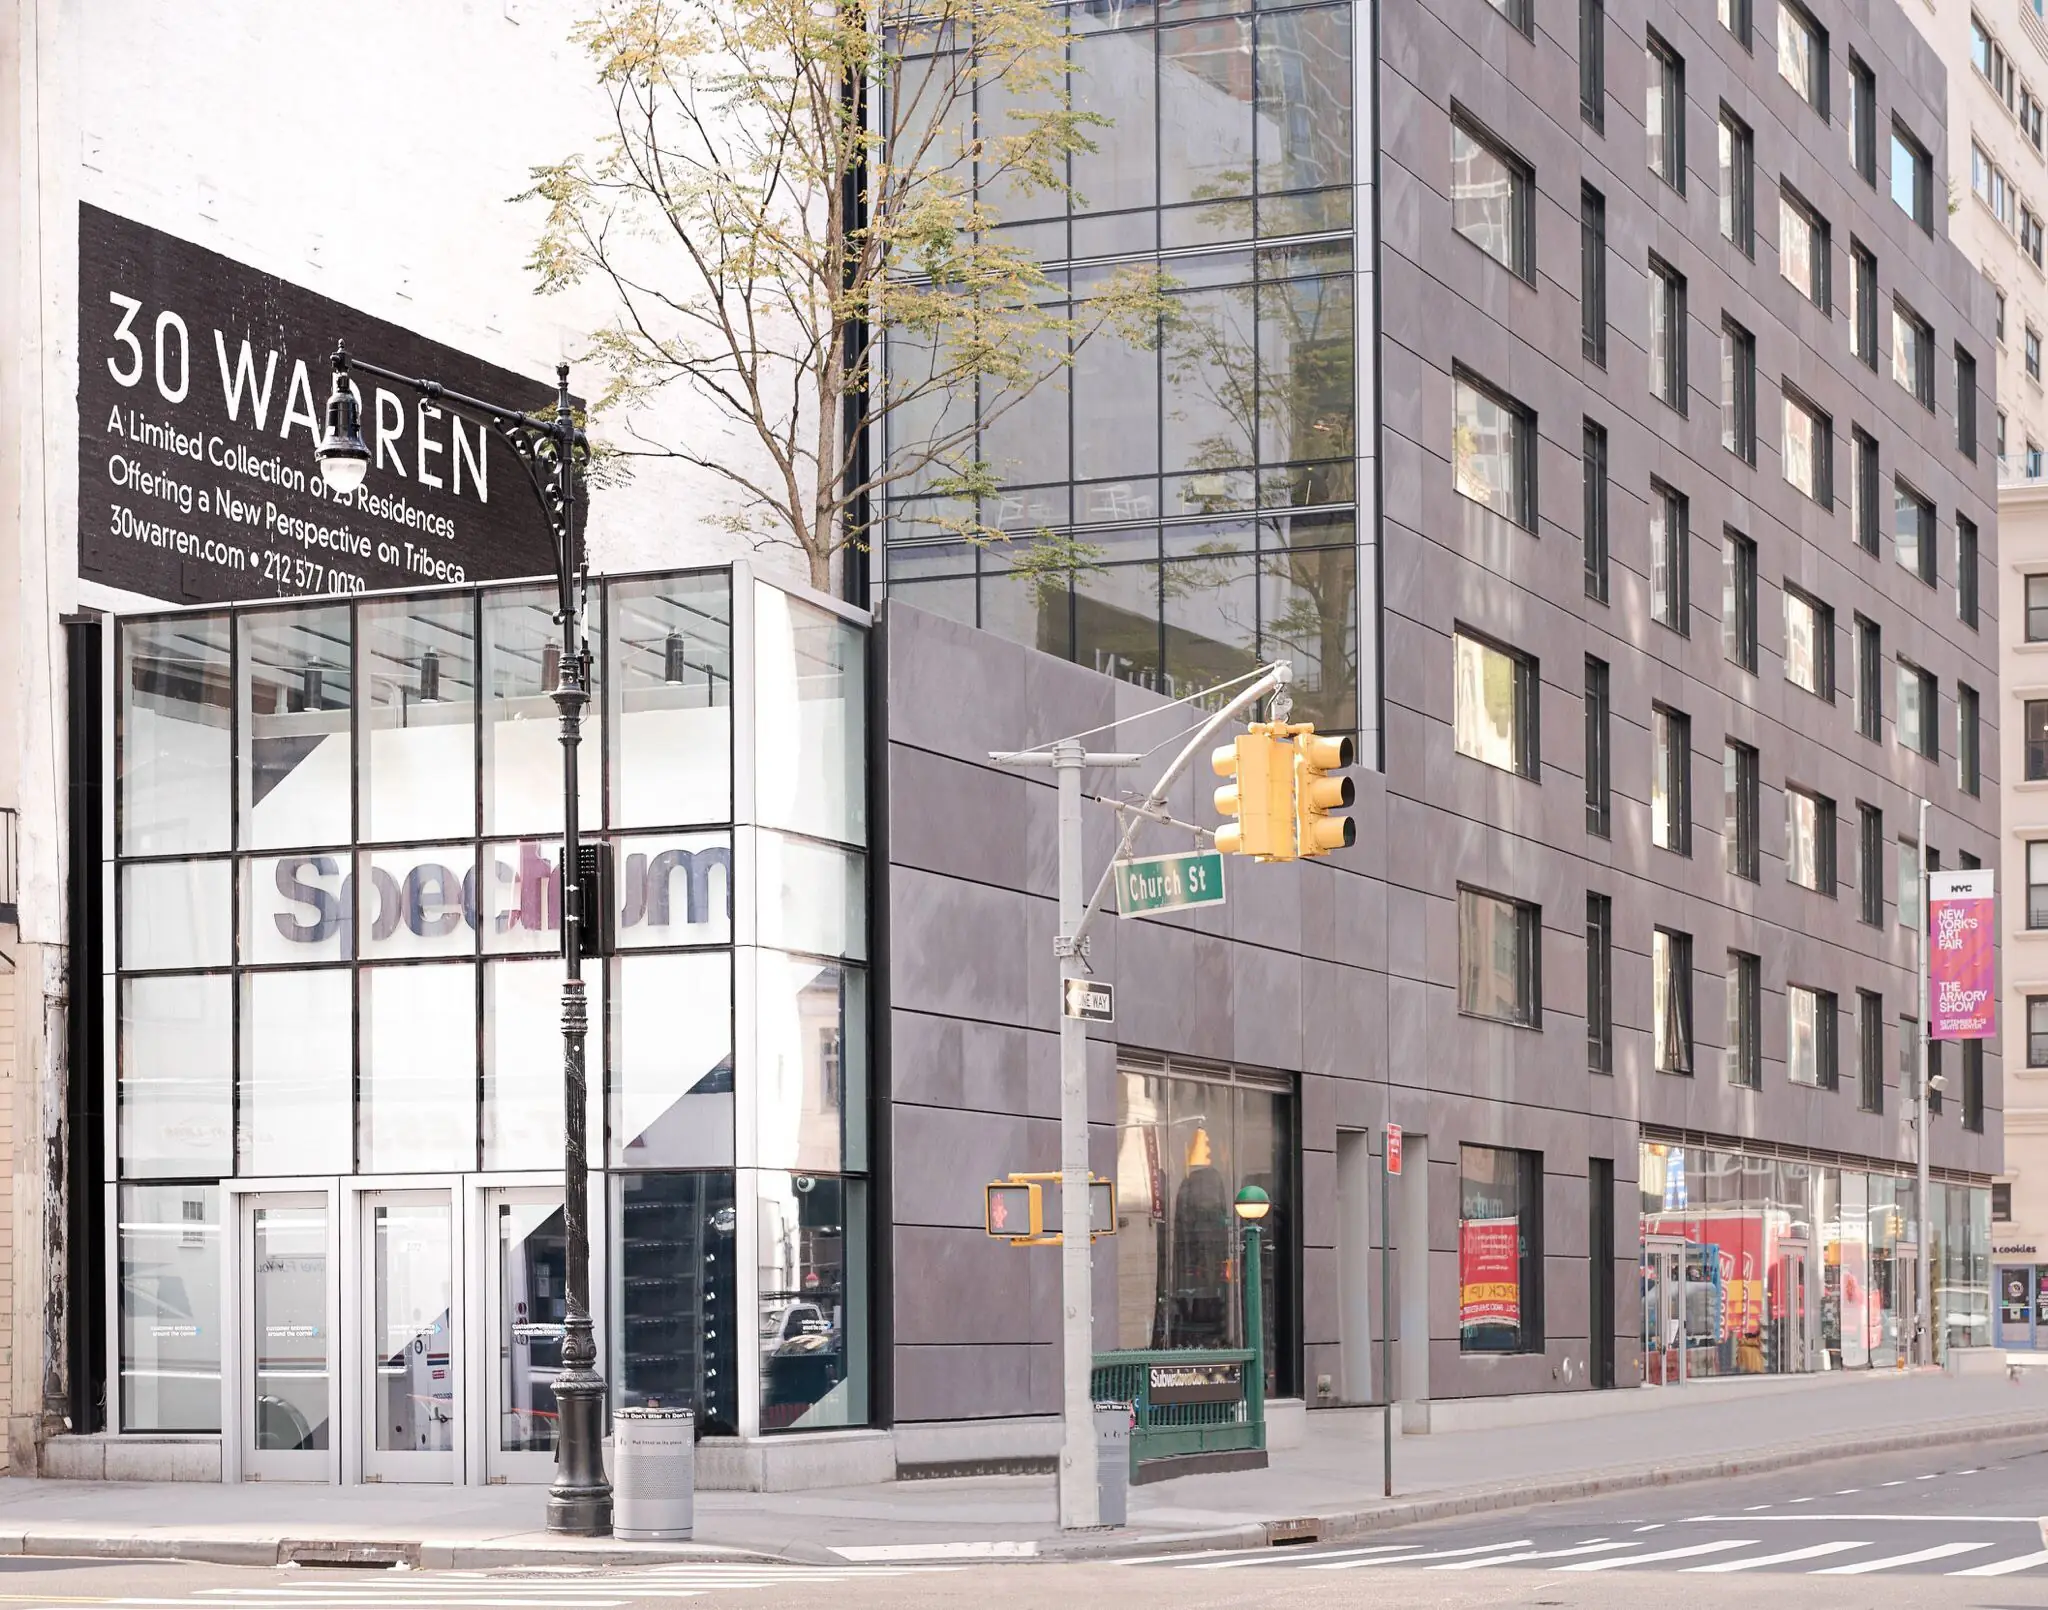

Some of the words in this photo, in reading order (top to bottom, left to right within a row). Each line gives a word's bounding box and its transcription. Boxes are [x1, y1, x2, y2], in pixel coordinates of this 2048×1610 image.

[106, 290, 190, 404] 30
[107, 405, 124, 437] A
[131, 410, 202, 461] Limited
[208, 436, 304, 493] Collection
[358, 483, 455, 540] Residences
[108, 454, 192, 514] Offering
[198, 490, 209, 513] a
[215, 486, 262, 526] New
[266, 501, 372, 558] Perspective
[378, 542, 400, 567] on
[404, 541, 465, 583] Tribeca
[110, 504, 245, 571] 30warren.com
[264, 550, 291, 584] 212
[295, 559, 324, 592] 577
[1129, 868, 1181, 901] Church
[1188, 864, 1207, 893] St
[1951, 884, 1972, 892] NYC
[274, 839, 730, 960] Spectm
[1938, 908, 1965, 920] NEW
[1938, 918, 1978, 930] YORK'S
[1939, 929, 1961, 940] ART
[1939, 939, 1963, 950] FAIR
[1939, 981, 1961, 992] THE
[1093, 994, 1108, 1009] WAY
[1939, 990, 1987, 1002] ARMORY
[1939, 1001, 1975, 1012] SHOW
[1998, 1243, 2036, 1253] cookies
